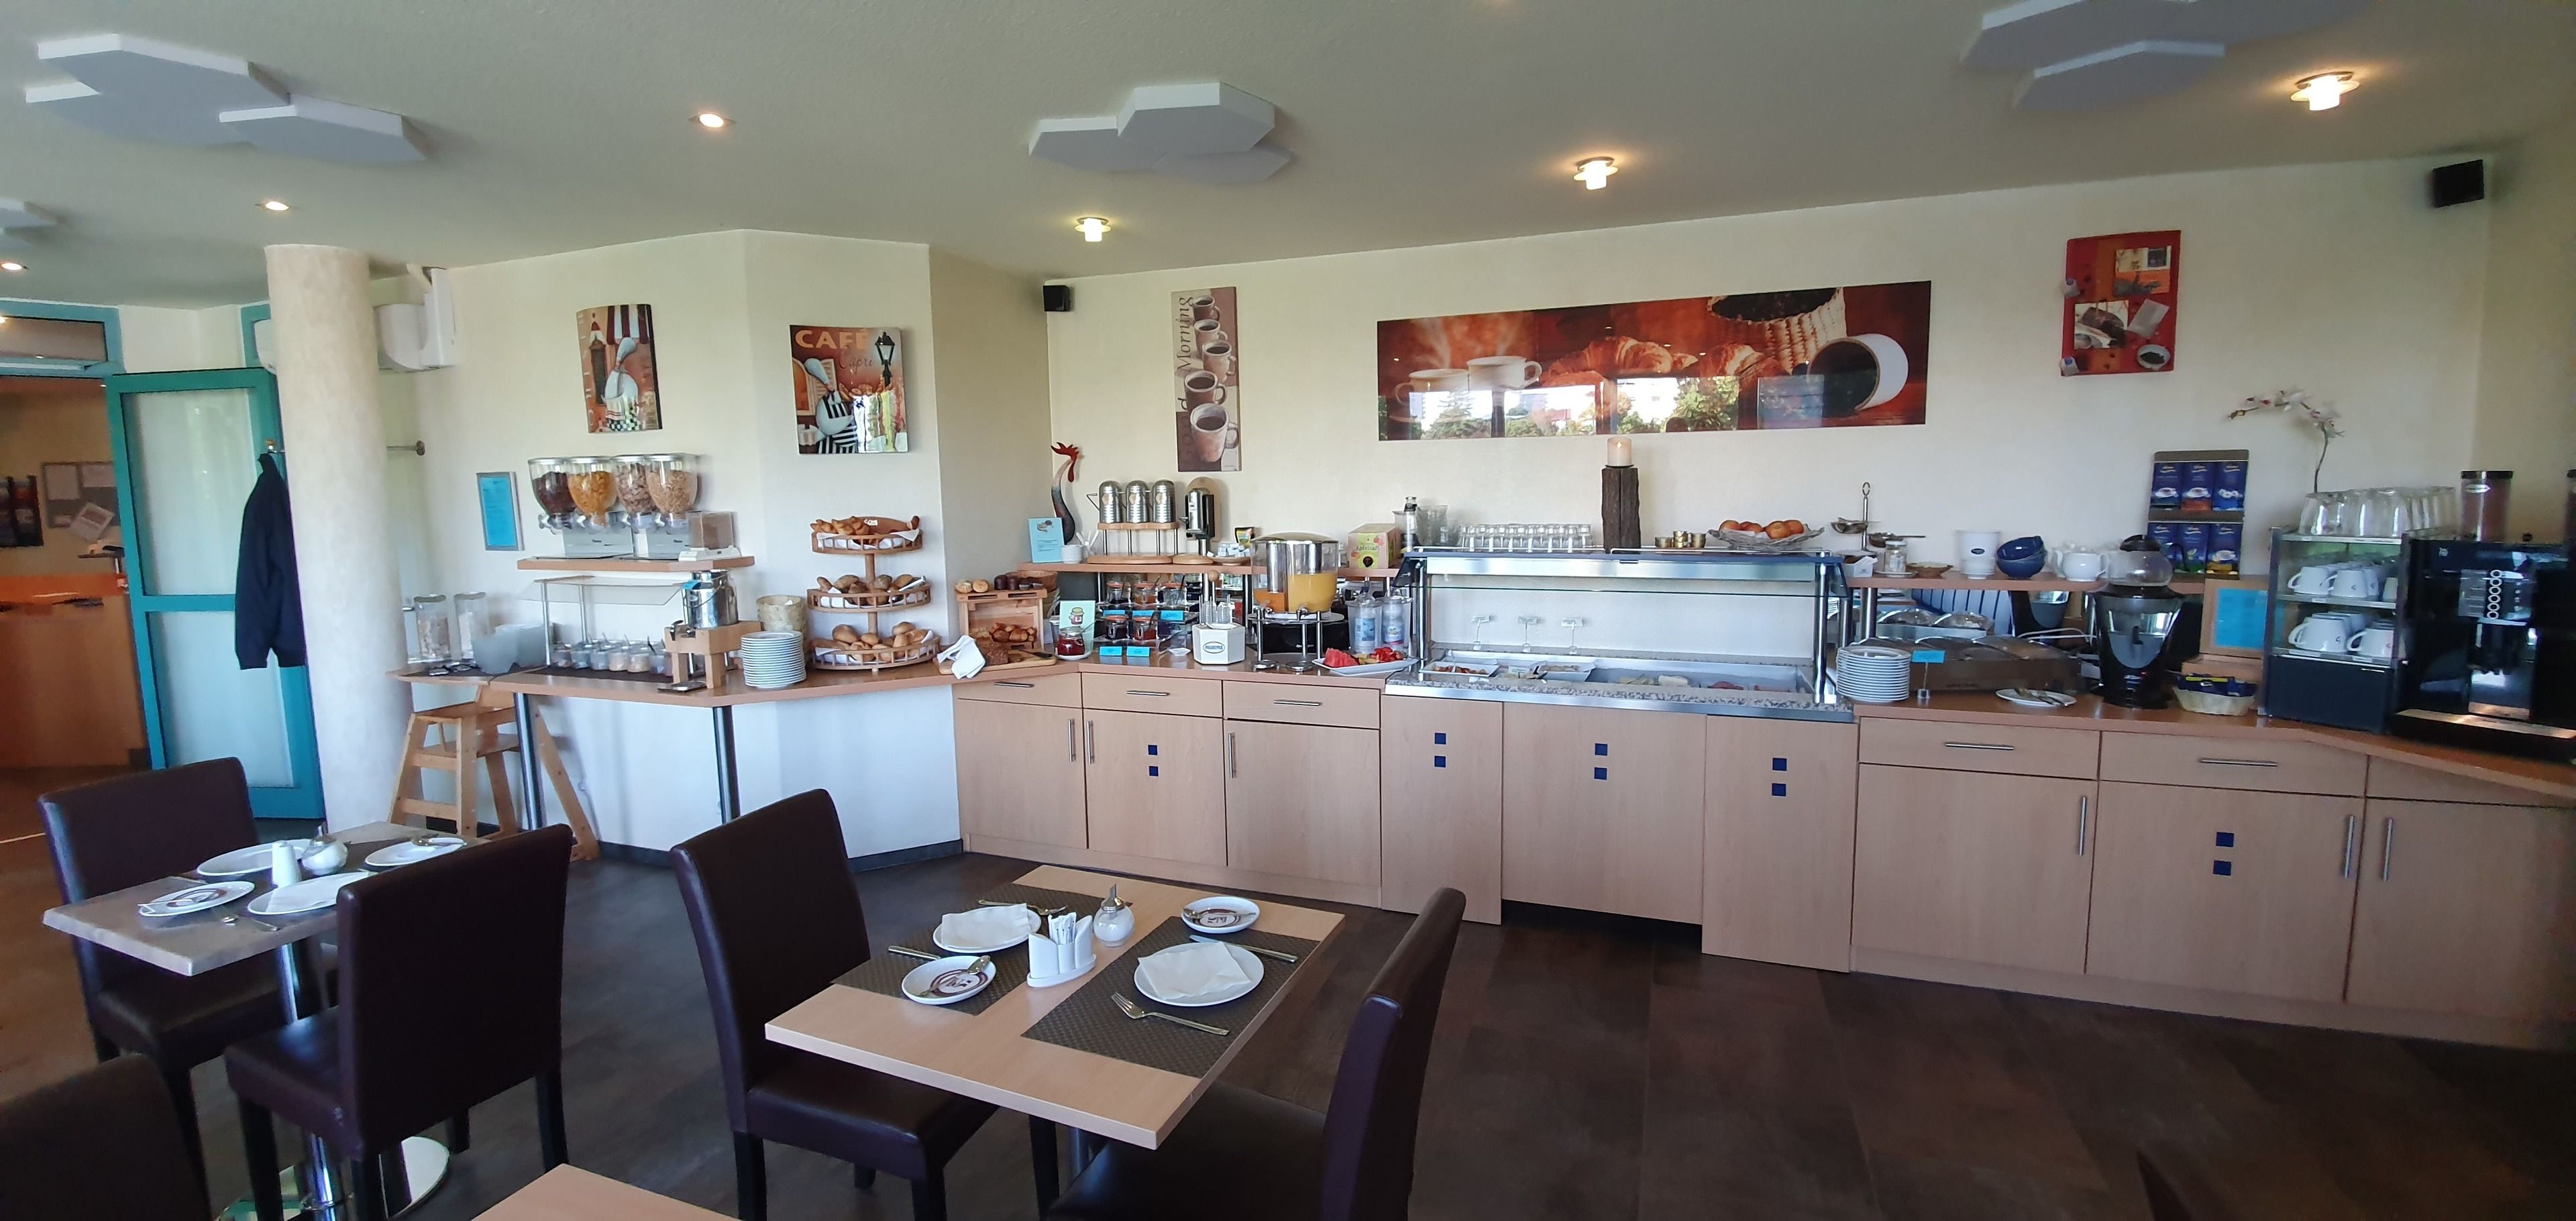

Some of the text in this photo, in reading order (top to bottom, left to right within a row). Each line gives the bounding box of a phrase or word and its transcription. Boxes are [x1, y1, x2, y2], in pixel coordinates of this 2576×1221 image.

[795, 329, 867, 350] CAFÉ
[1176, 297, 1193, 371] Morning
[839, 347, 874, 375] Capri
